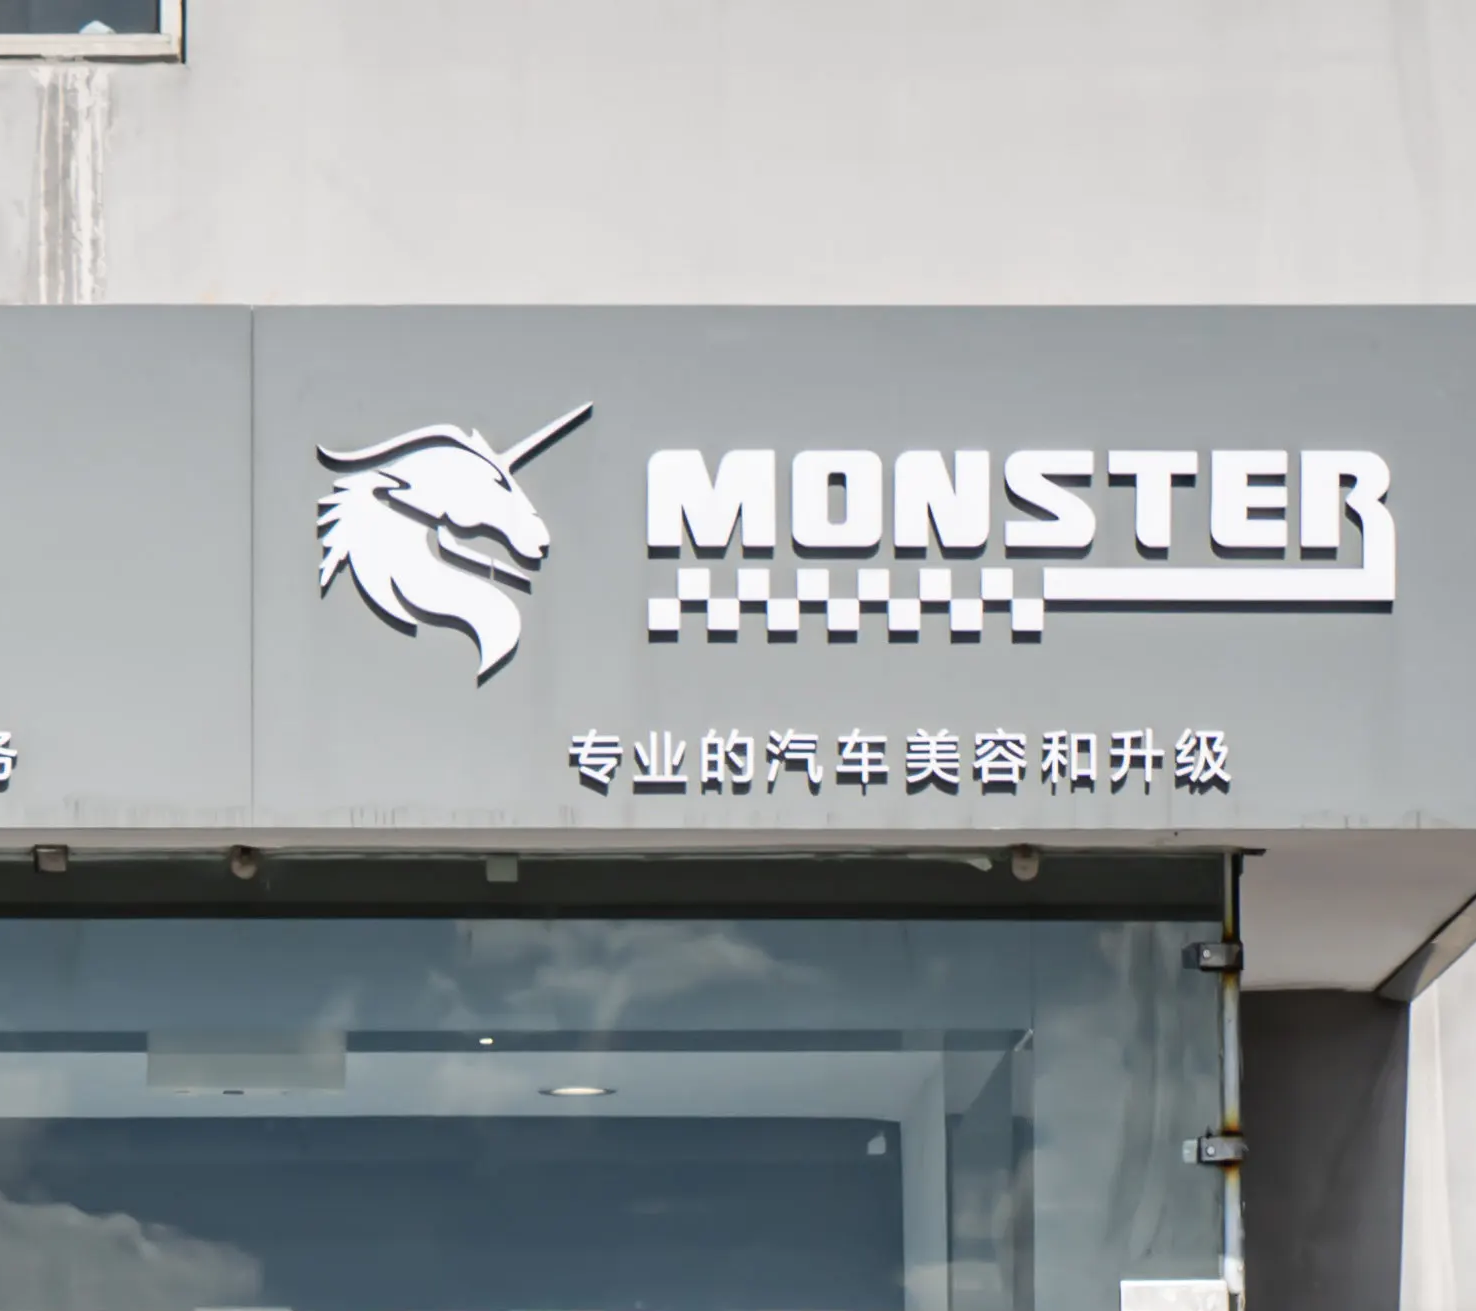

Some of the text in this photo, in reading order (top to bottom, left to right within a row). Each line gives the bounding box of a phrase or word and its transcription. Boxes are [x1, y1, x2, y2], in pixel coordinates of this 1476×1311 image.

[647, 449, 1396, 599] MONSTER
[568, 727, 1234, 785] 专业的汽车美容和升级
